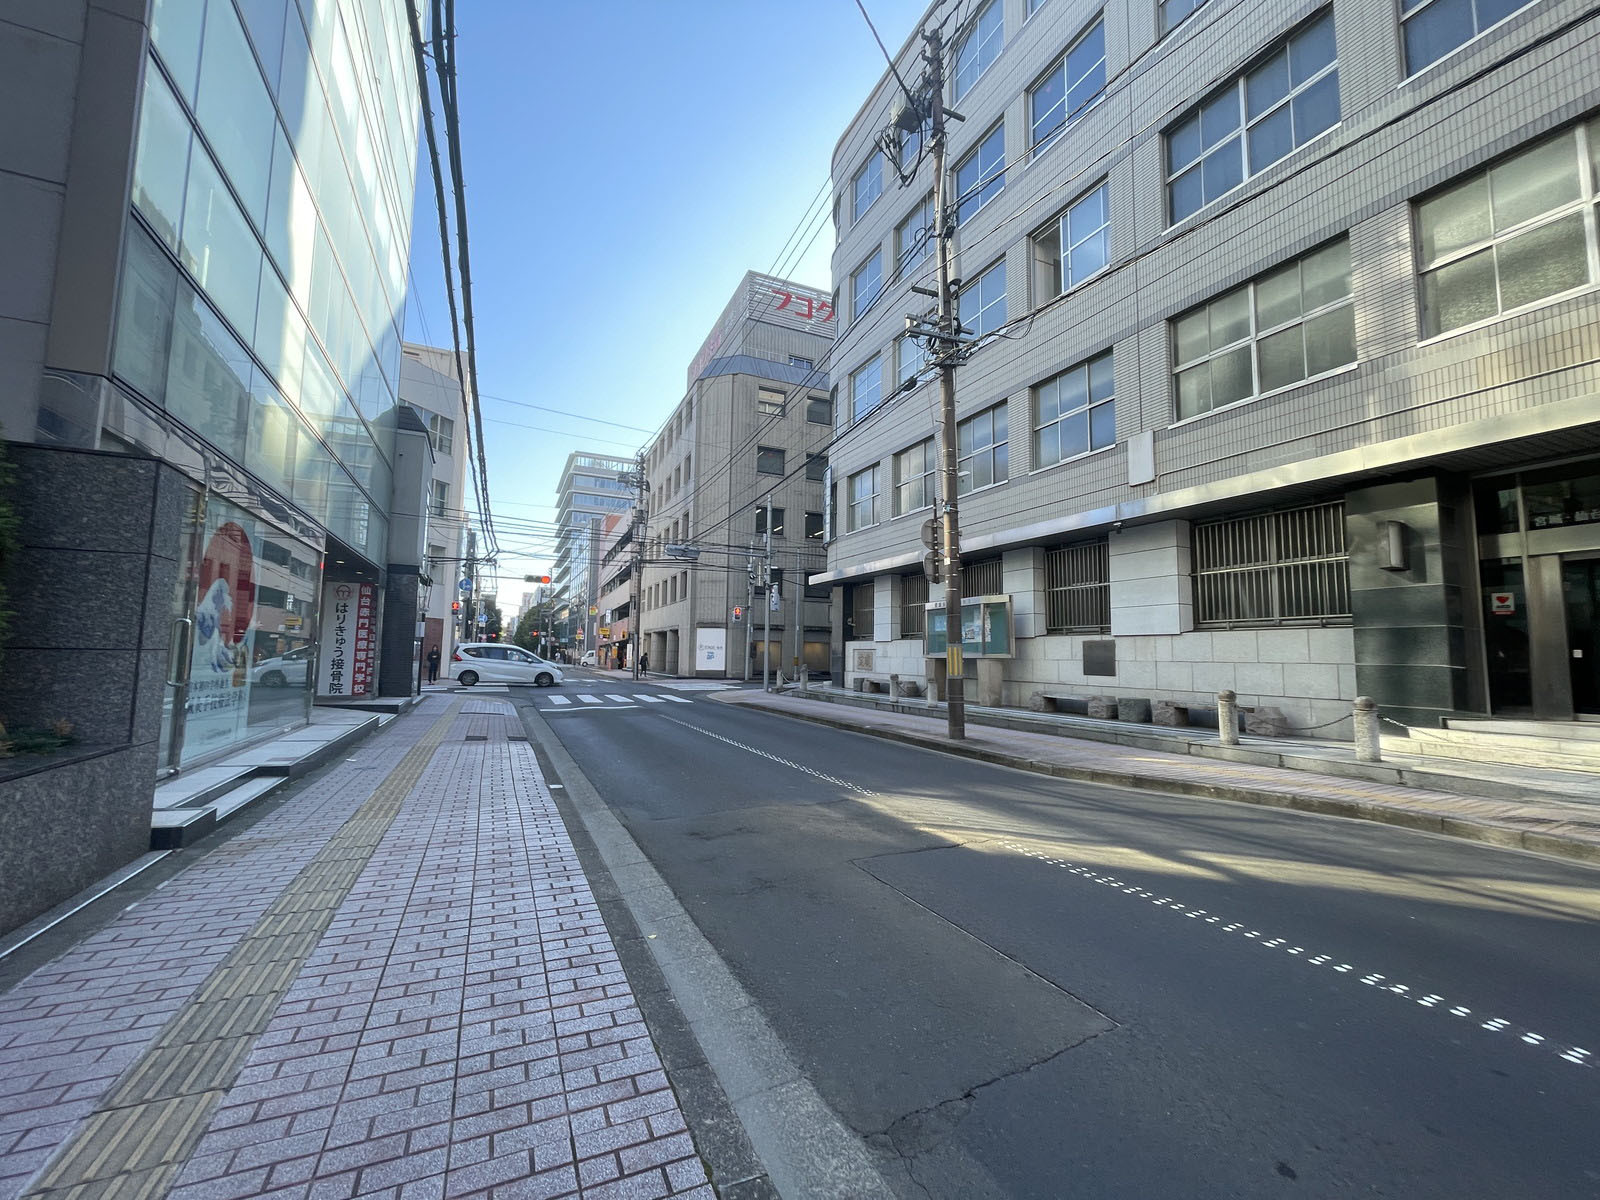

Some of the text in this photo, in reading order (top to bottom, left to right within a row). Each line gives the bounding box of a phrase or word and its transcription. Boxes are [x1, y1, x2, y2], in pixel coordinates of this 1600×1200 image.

[771, 289, 836, 323] フコク
[329, 602, 349, 694] はりきゅう接骨院
[353, 585, 372, 694] 仙台赤門医療専門学校
